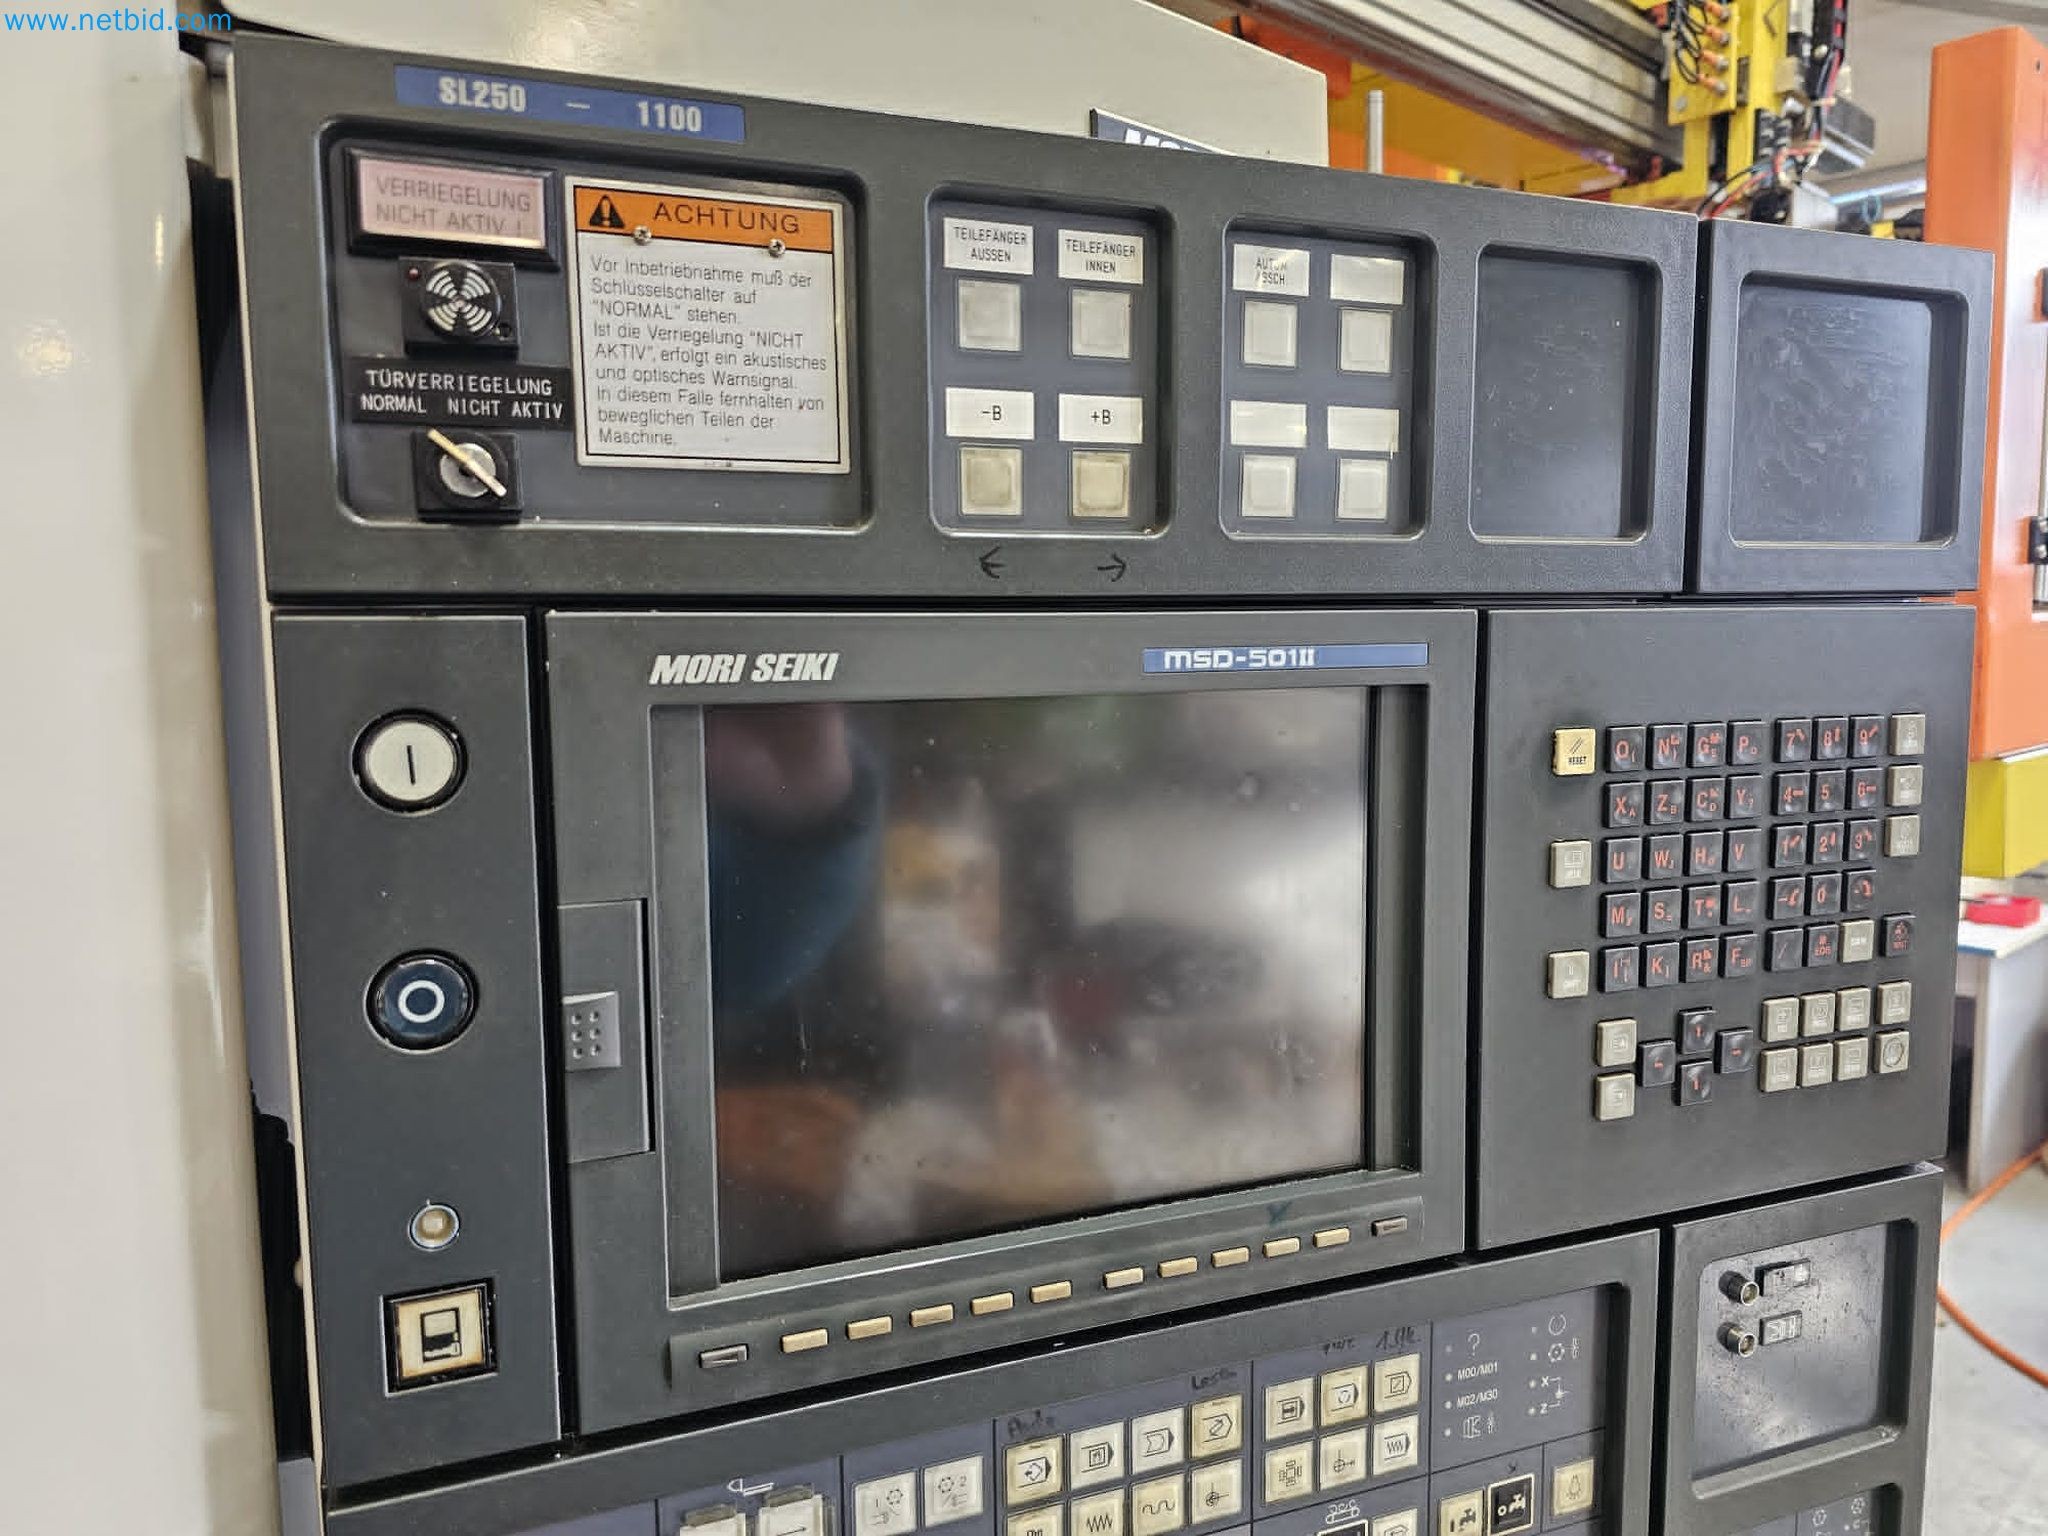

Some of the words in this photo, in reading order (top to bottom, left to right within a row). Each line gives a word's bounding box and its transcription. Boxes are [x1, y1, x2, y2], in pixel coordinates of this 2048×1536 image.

[438, 76, 527, 112] SL250
[638, 100, 702, 132] 1100
[376, 176, 531, 213] VERRIEGELUNG
[376, 203, 437, 227] NICHT
[446, 211, 505, 233] AKTIV
[654, 202, 800, 234] ACHTUNG
[953, 226, 1028, 245] TEILEFÄNGER
[970, 247, 1011, 263] AUSSEN
[1065, 238, 1136, 258] TEILEFÄNGER
[591, 255, 619, 273] Vor
[625, 257, 744, 284] Inbetriebnahme
[751, 269, 783, 287] muß
[789, 272, 812, 288] der
[1086, 260, 1116, 274] INNEN
[733, 289, 757, 304] auf
[594, 320, 611, 337] Ist
[617, 324, 641, 339] die
[647, 324, 744, 349] Verriegelung
[661, 346, 709, 367] erfolgt
[714, 351, 737, 365] ein
[743, 351, 827, 371] akustisches
[365, 369, 552, 397] TÜRVERRIEGELUNG
[595, 365, 626, 381] und
[632, 368, 706, 385] optisches
[360, 392, 427, 414] NORMAL
[448, 398, 501, 416] NICHT
[511, 402, 563, 419] AKTIV
[597, 385, 611, 402] In
[616, 385, 672, 403] diesem
[678, 388, 714, 405] Falle
[719, 391, 793, 410] fernhalten
[798, 398, 824, 411] von
[598, 406, 695, 428] beweglichen
[701, 410, 745, 428] Teilen
[749, 415, 774, 430] der
[982, 405, 1002, 421] -B
[1091, 409, 1112, 425] +B
[649, 653, 748, 685] MORI
[751, 652, 841, 683] SEIKI
[1698, 737, 1709, 754] G
[1738, 736, 1749, 752] P
[1823, 730, 1832, 747] 8
[1860, 729, 1868, 746] 9
[1658, 738, 1670, 756] N
[1697, 792, 1708, 808] C
[1783, 786, 1793, 803] 4
[1820, 783, 1830, 800] 5
[1615, 796, 1627, 814] X
[1657, 794, 1669, 812] Z
[1735, 843, 1745, 861] V
[1819, 836, 1828, 852] 2
[1613, 851, 1625, 870] U
[1654, 849, 1669, 869] W
[1695, 848, 1706, 865] H
[1654, 902, 1665, 920] S
[1695, 899, 1704, 917] T
[1733, 896, 1743, 913] L
[1611, 905, 1624, 925] M
[1652, 956, 1663, 974] K
[1731, 948, 1742, 966] F
[1457, 1361, 1498, 1381] M00/M01
[1456, 1388, 1498, 1410] M02/M30
